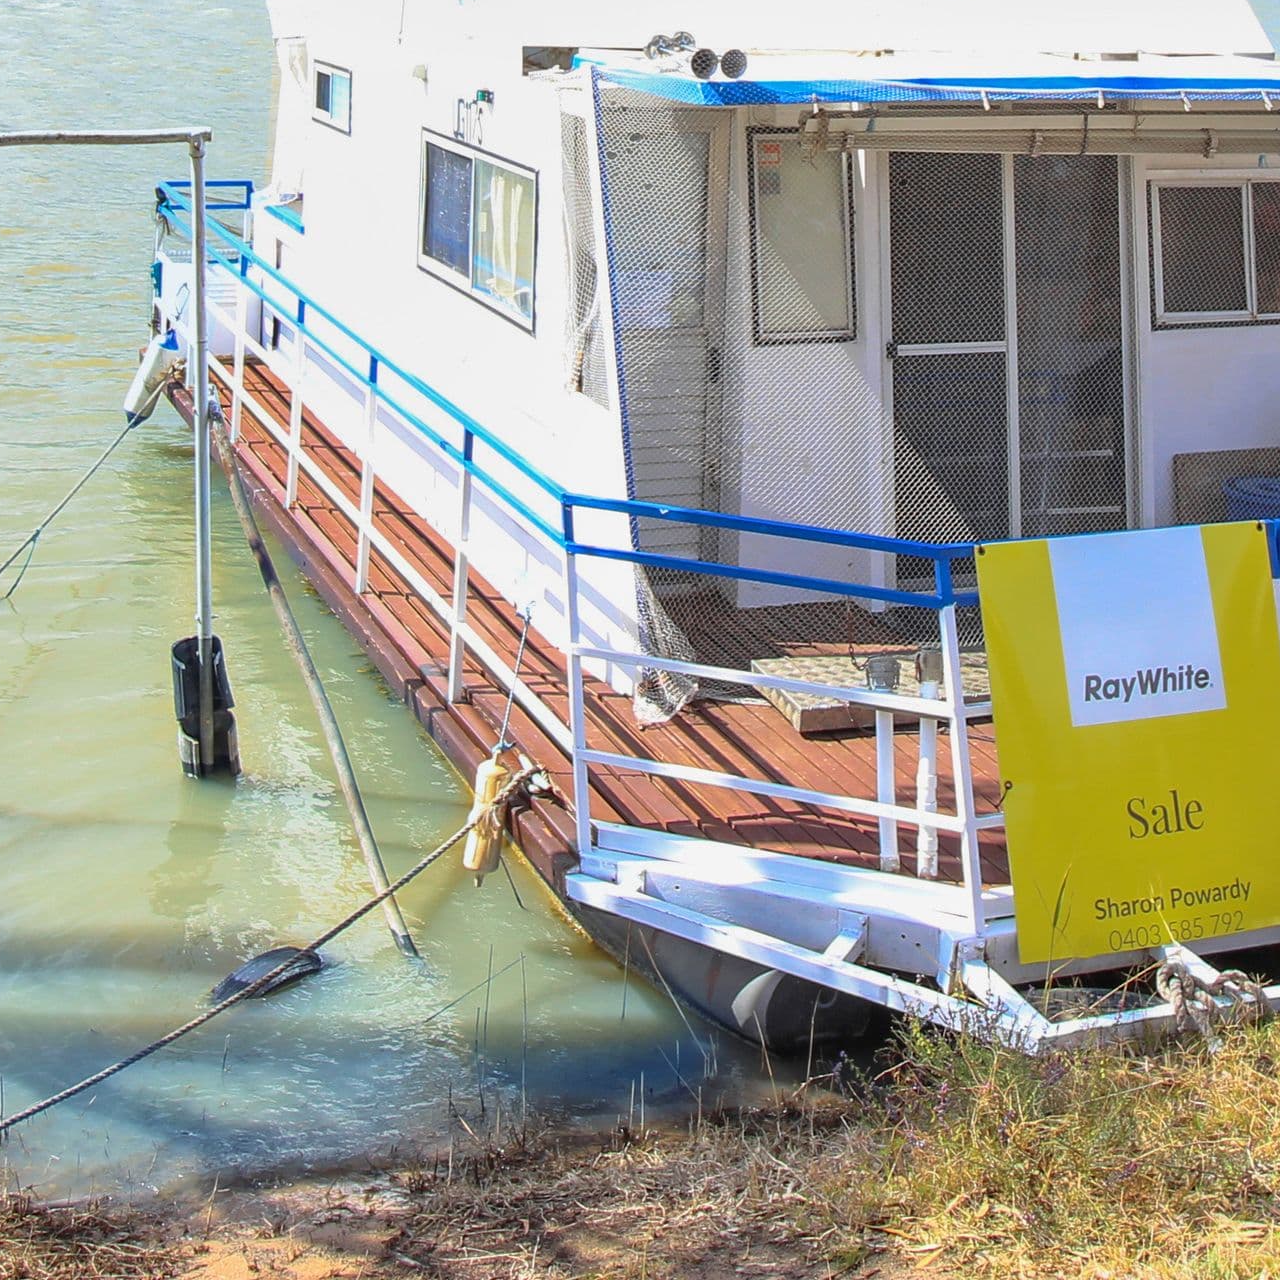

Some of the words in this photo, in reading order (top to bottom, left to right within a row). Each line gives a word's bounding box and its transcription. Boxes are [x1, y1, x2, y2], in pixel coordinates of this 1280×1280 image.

[1126, 789, 1206, 839] Sale
[1094, 896, 1165, 921] Sharon
[1170, 877, 1252, 909] Powardy
[1108, 923, 1162, 952] 0403
[1170, 916, 1204, 942] 585
[1209, 910, 1245, 935] 792
